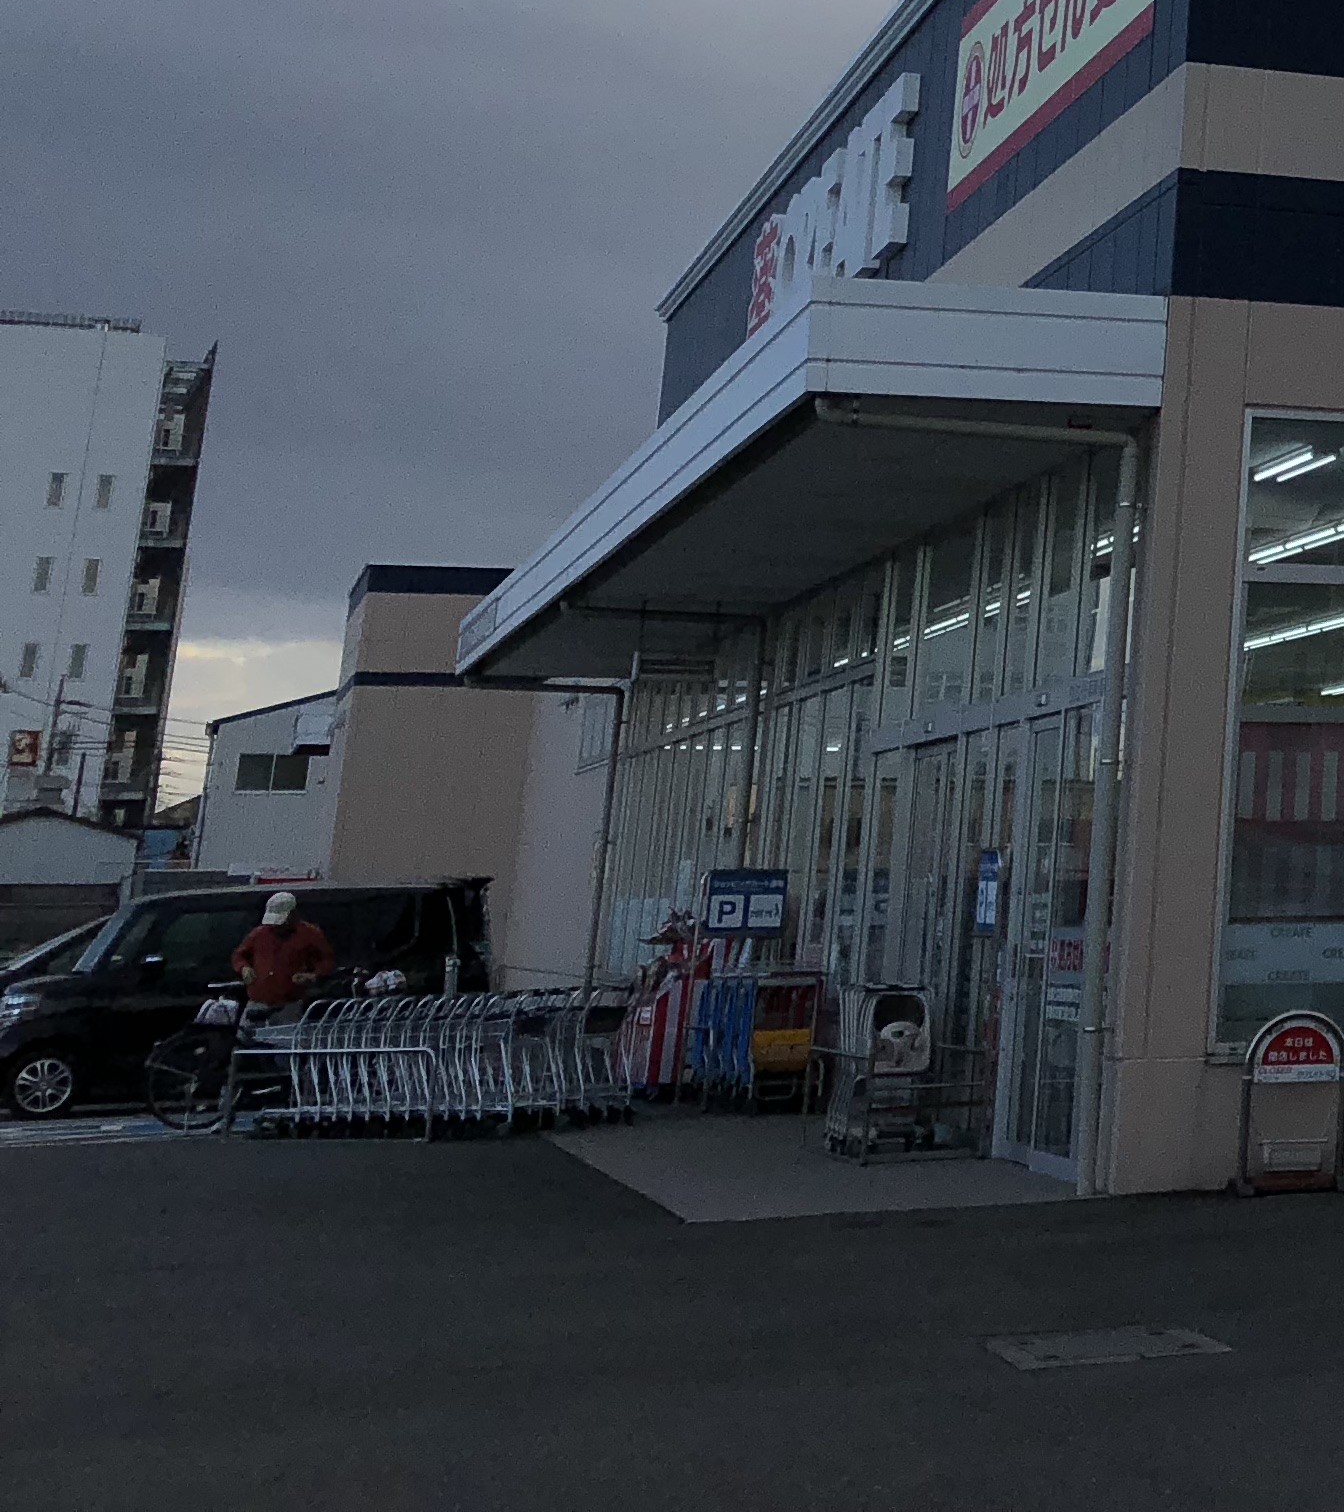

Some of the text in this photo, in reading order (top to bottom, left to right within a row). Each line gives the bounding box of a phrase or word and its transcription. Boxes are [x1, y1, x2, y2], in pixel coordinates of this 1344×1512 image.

[717, 901, 736, 924] P
[1284, 1037, 1314, 1047] 本日は
